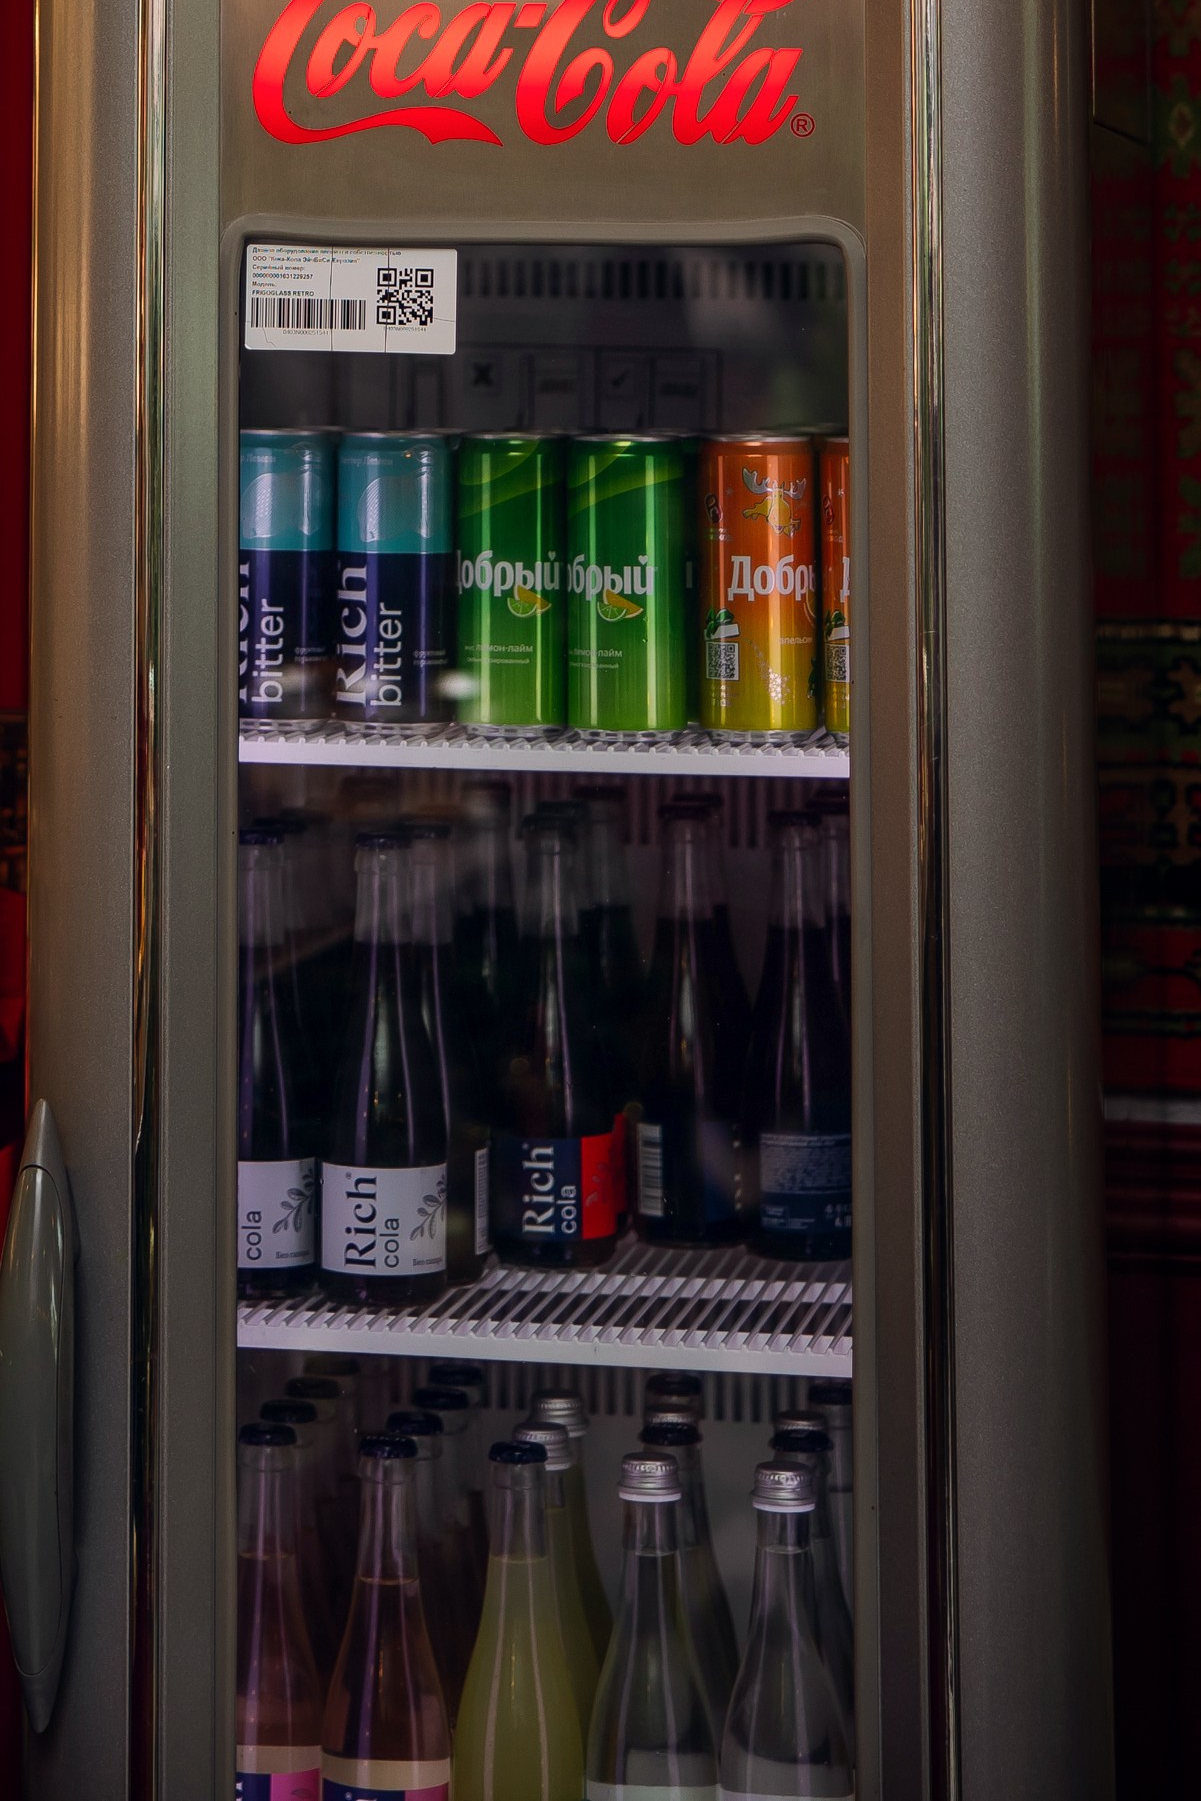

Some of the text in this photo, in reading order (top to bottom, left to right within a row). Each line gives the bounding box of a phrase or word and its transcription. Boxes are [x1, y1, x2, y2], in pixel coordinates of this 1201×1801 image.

[457, 549, 560, 597] обрый
[567, 553, 655, 601] брый
[251, 598, 285, 703] bitter
[336, 563, 368, 708] Rich
[370, 601, 403, 707] bitter
[344, 1175, 377, 1269] Rich
[522, 1145, 556, 1235] Rich
[555, 1184, 577, 1235] cola
[241, 1210, 262, 1261] cola
[379, 1217, 400, 1269] cola
